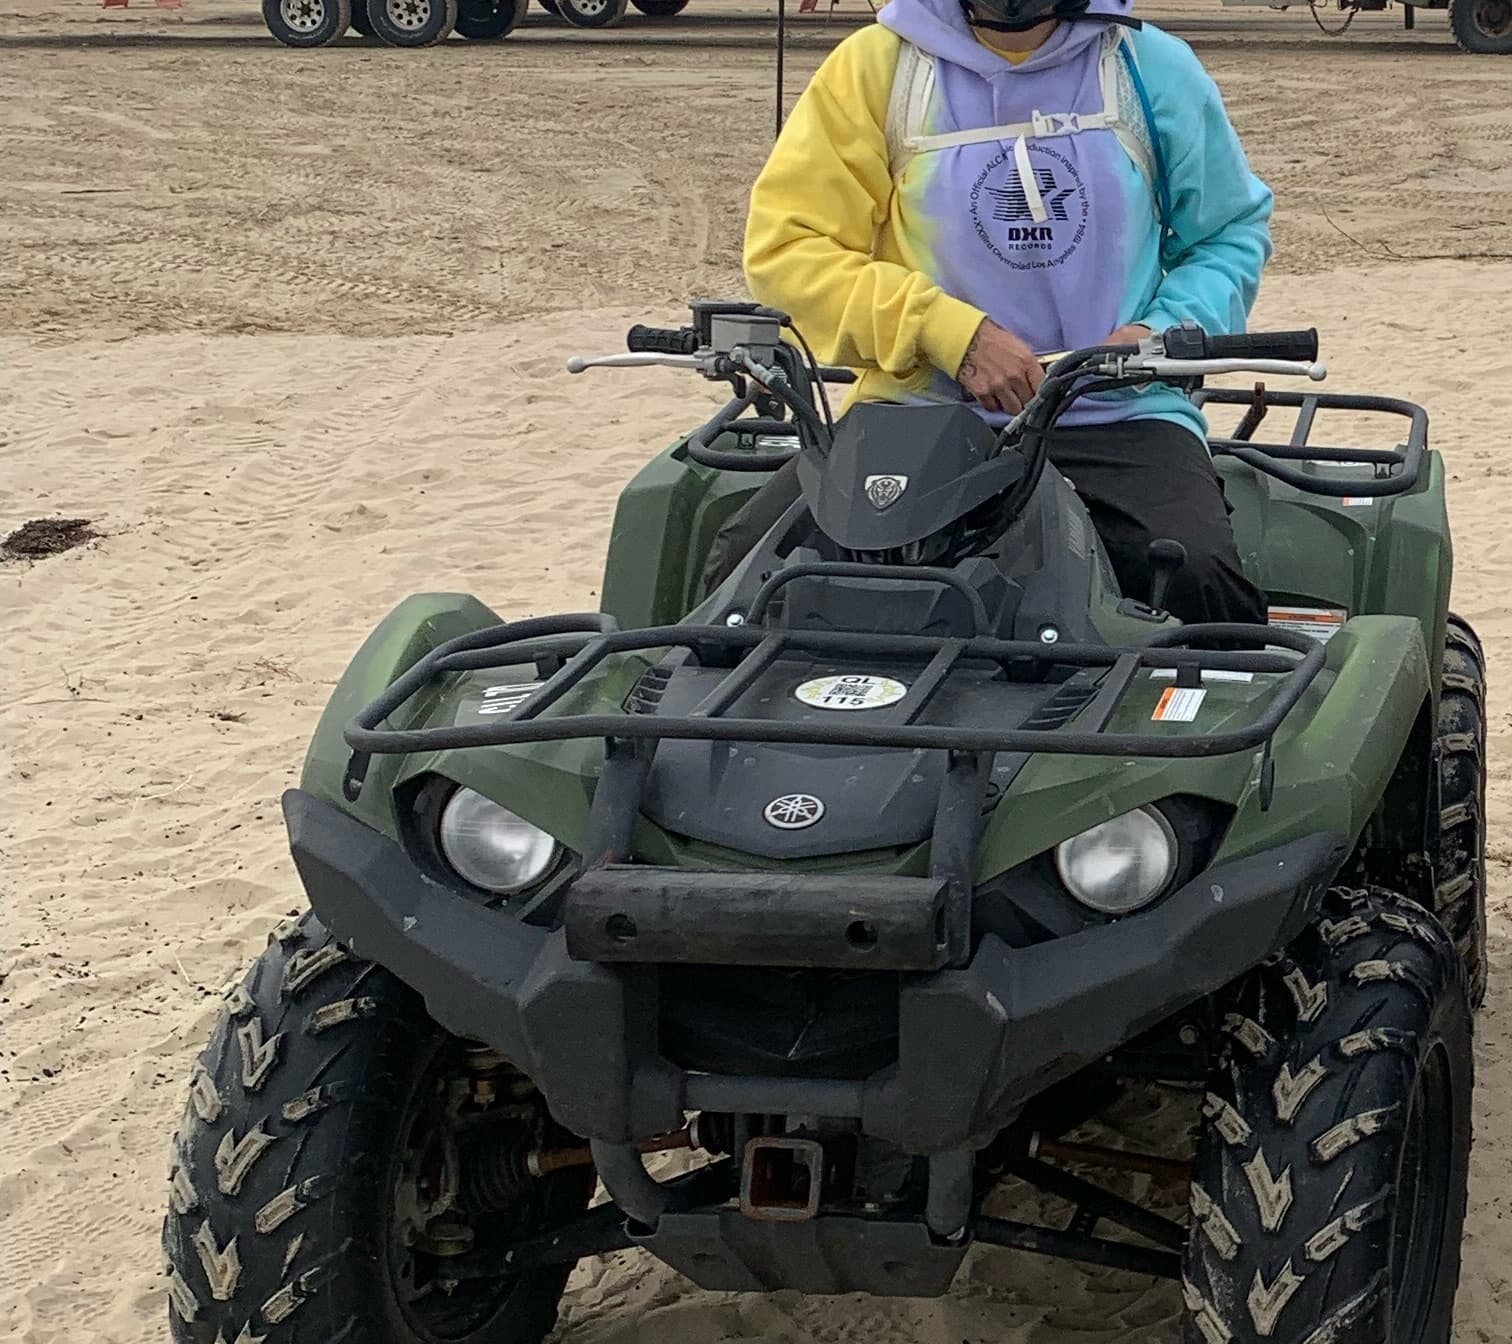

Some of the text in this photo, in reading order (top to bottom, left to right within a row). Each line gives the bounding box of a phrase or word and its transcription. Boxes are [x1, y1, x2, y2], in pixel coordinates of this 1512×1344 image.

[970, 169, 988, 200] Official
[1008, 227, 1053, 241] DXR
[1047, 245, 1076, 267] Angeles
[823, 696, 864, 705] 115
